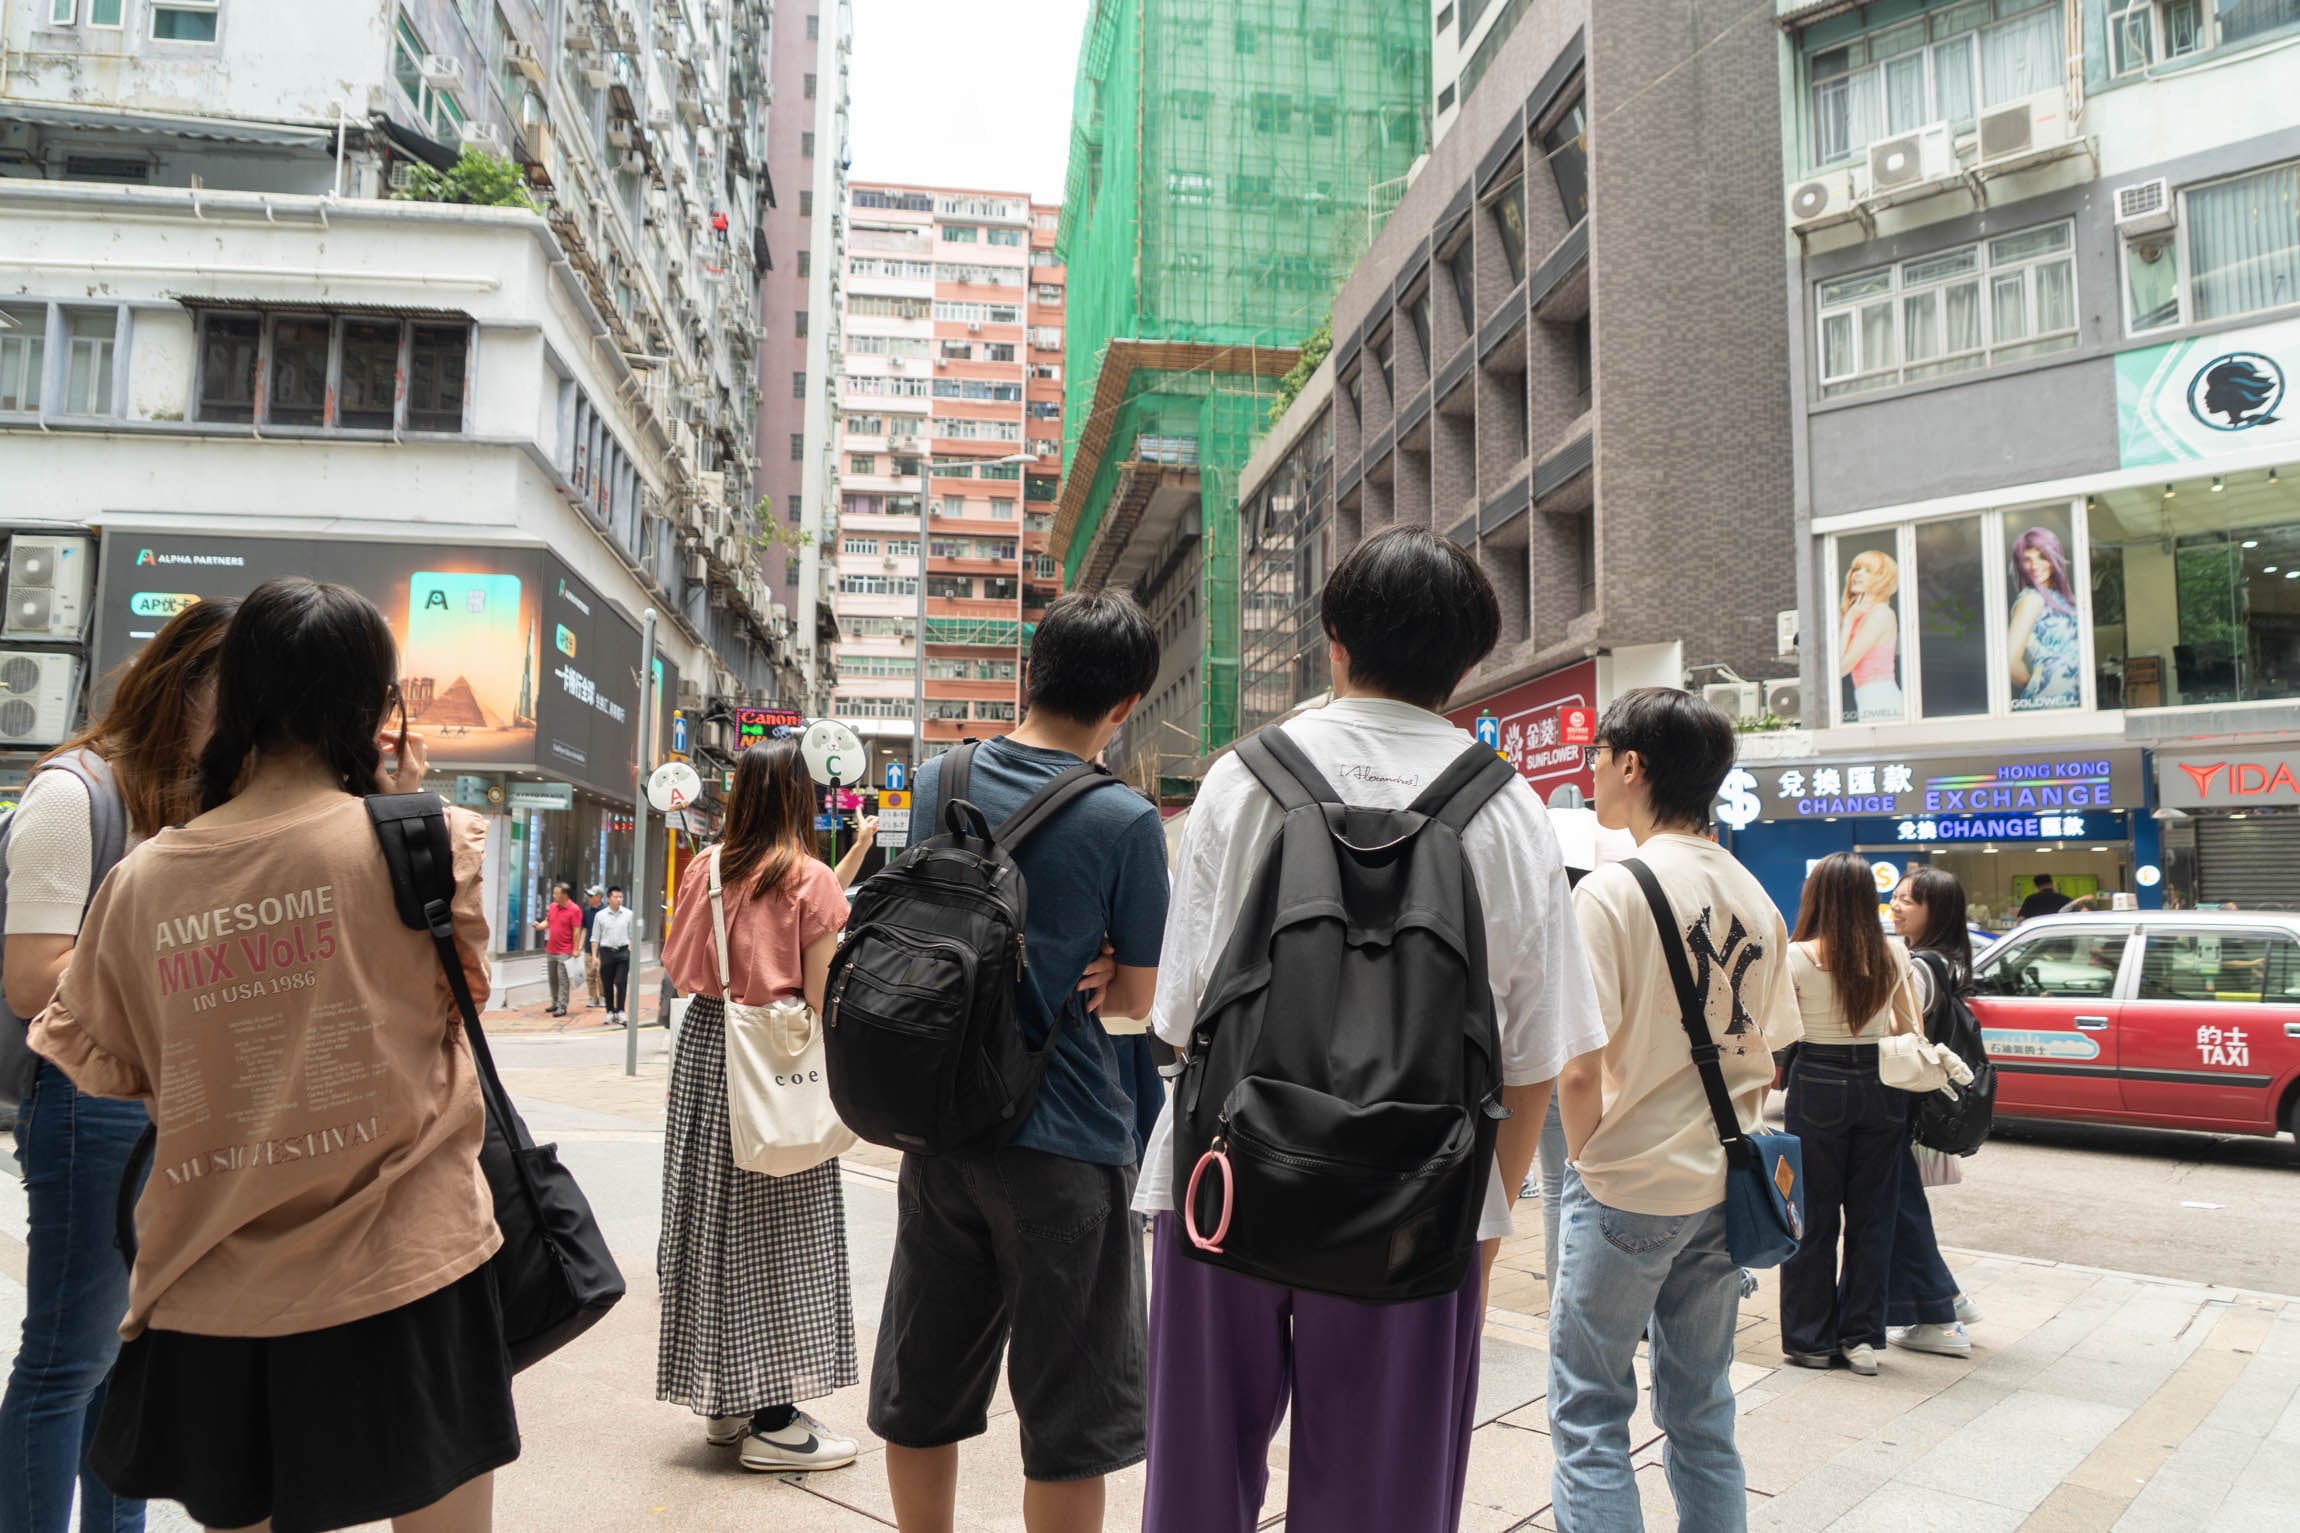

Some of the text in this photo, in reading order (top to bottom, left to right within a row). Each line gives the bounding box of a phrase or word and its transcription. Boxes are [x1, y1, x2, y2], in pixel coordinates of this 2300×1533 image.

[157, 554, 192, 565] ALPHA
[193, 556, 244, 567] PARTNERS
[2011, 694, 2080, 709] GOLDWELL
[741, 711, 798, 726] Canon
[825, 755, 842, 776] C
[1526, 744, 1580, 770] SUNFLOWER
[1998, 760, 2110, 780] HONG KONG
[1778, 764, 1914, 798] 兌換匯款
[670, 787, 685, 804] A
[1798, 796, 1897, 815] CHANGE
[1925, 783, 2112, 811] EXCHANGE
[1938, 817, 2039, 838] CHANGE
[156, 885, 334, 951] AWESOME
[158, 919, 336, 996] MIX Vol.5
[193, 970, 317, 1013] IN USA 1986
[2197, 1025, 2249, 1046] 的士
[2196, 1045, 2249, 1067] TAXI
